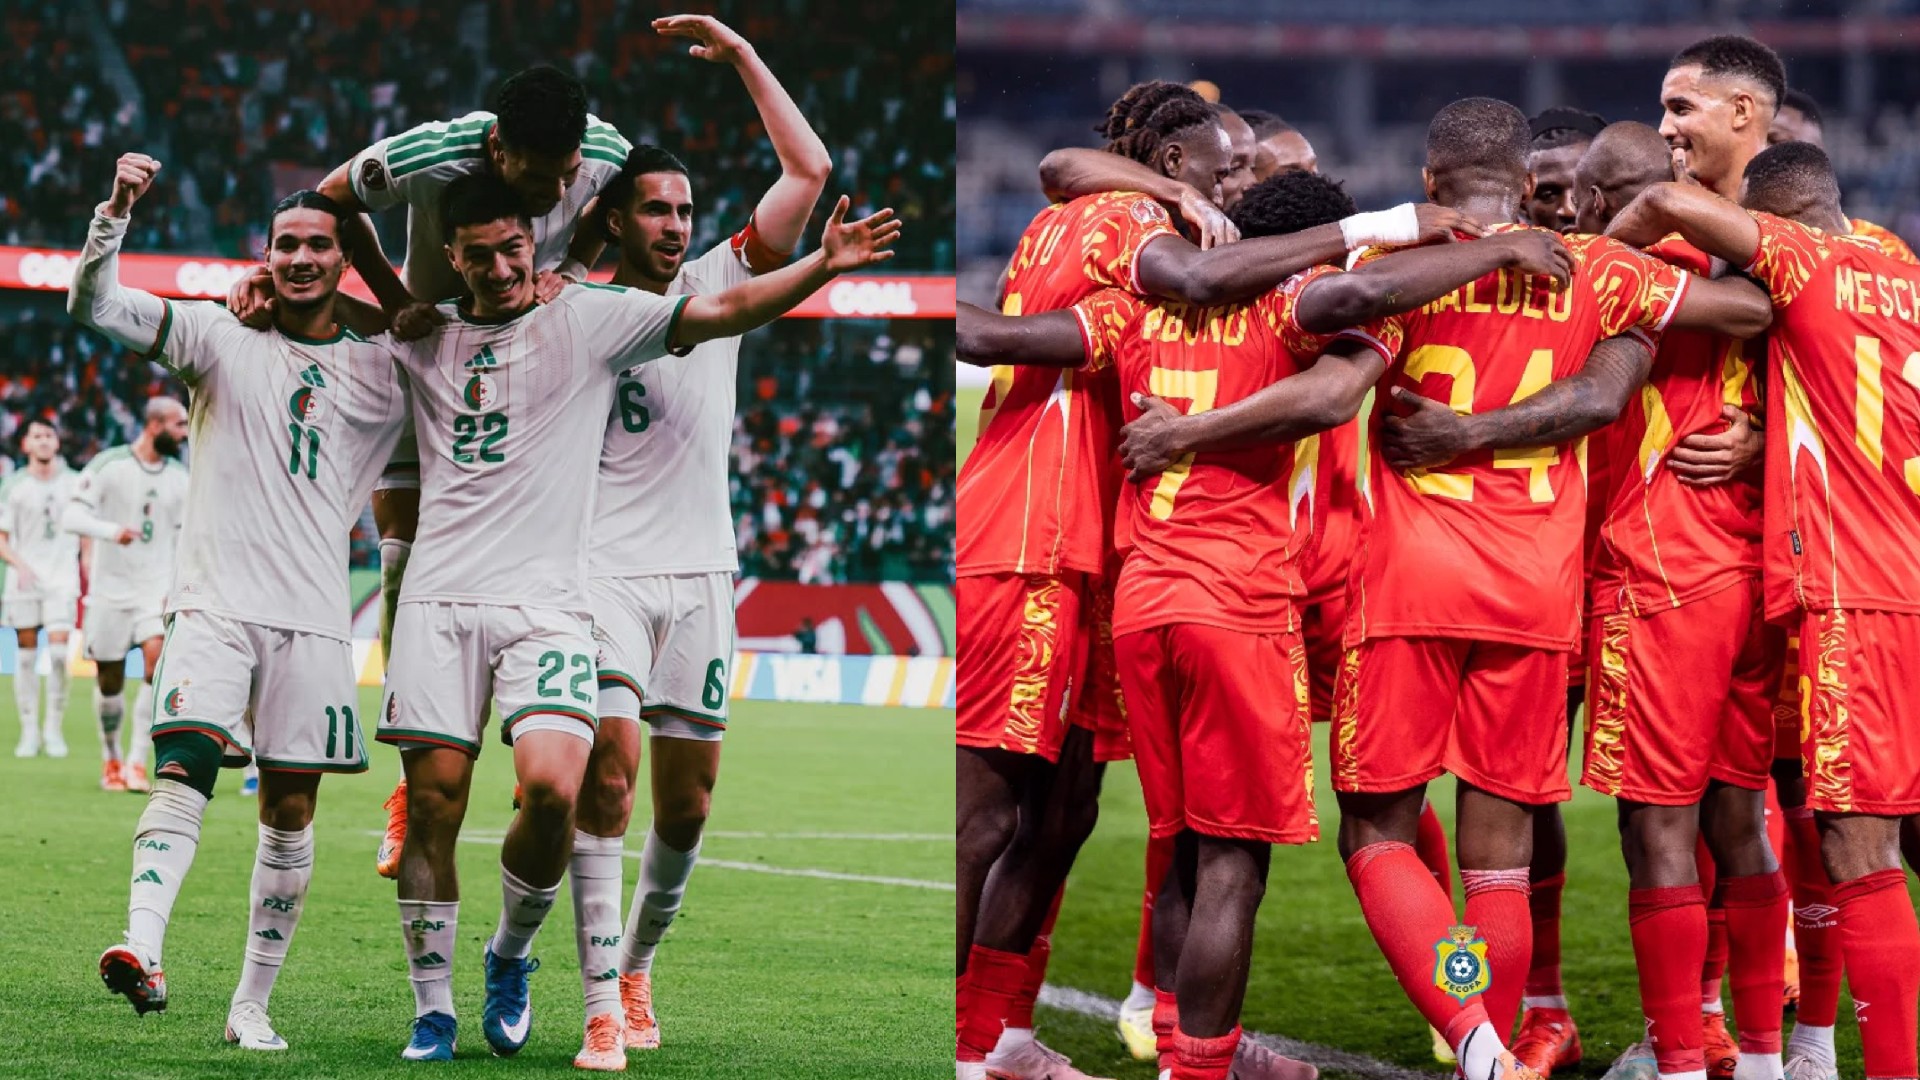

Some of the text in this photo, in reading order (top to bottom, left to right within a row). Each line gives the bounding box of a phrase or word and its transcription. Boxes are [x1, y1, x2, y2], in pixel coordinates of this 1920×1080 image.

[18, 252, 82, 288] GO
[1421, 267, 1572, 322] ALULU
[828, 281, 917, 315] GOAL
[619, 381, 649, 433] 6
[1403, 344, 1560, 502] 24
[289, 422, 320, 480] 11
[452, 412, 508, 463] 22
[1149, 366, 1219, 520] 7
[141, 520, 153, 543] 9
[537, 650, 592, 704] 22
[701, 658, 726, 710] 6
[770, 656, 842, 704] VISA
[325, 705, 353, 760] 11
[137, 839, 171, 852] FAF
[262, 897, 295, 913] FAF
[411, 920, 446, 931] FAF
[590, 935, 620, 948] FAF
